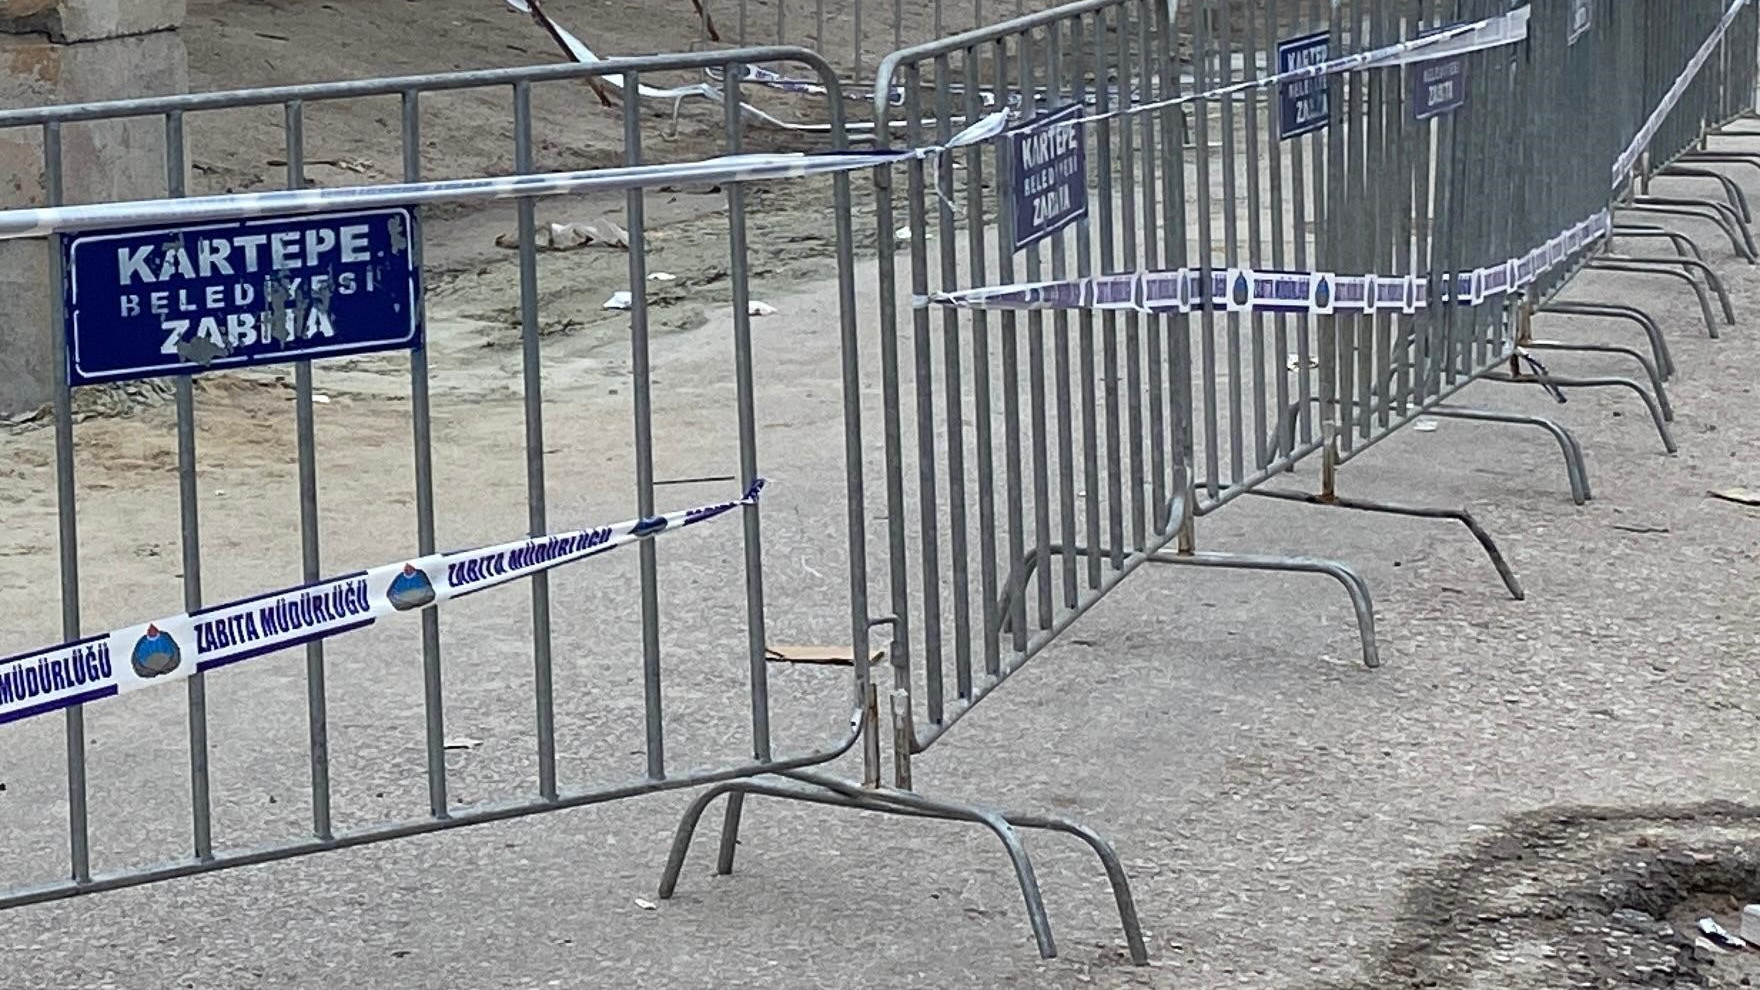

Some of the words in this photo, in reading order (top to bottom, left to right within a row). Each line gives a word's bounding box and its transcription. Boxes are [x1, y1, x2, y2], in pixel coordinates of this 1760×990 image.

[1022, 123, 1078, 171] KARTEPE
[116, 223, 372, 286] KARTEPE
[447, 551, 508, 587] ZABITA
[193, 611, 260, 655] ZABITA
[259, 578, 370, 638] MÜDÜRLÜĞÜ
